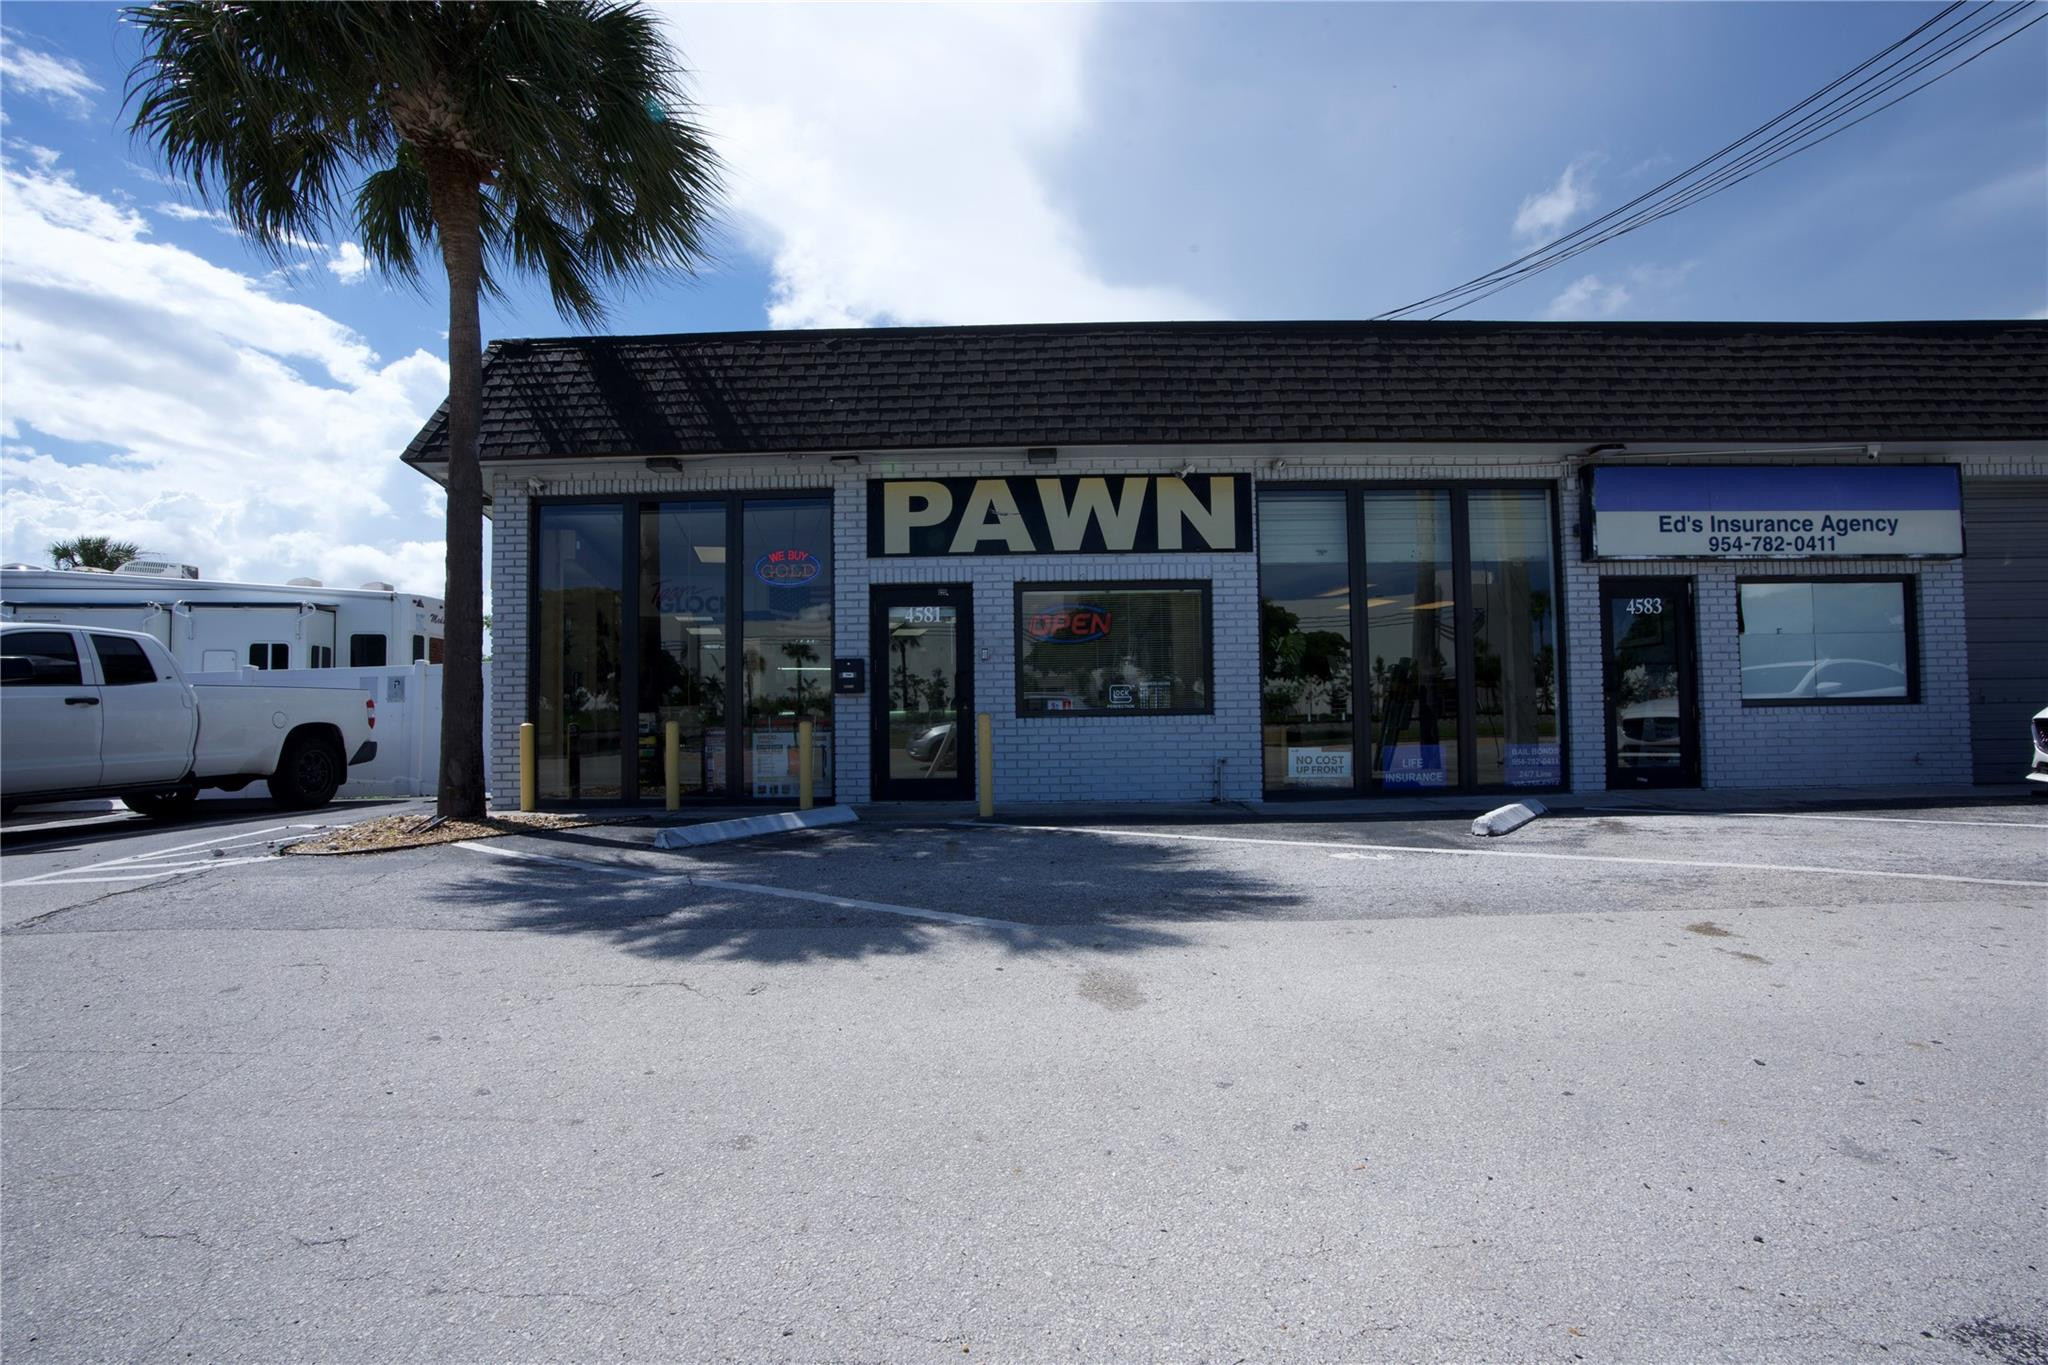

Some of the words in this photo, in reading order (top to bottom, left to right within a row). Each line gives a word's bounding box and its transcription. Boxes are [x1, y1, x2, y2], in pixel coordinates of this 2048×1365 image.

[883, 476, 1236, 555] PAWN
[1658, 515, 1704, 533] Ed's
[1710, 515, 1814, 533] Insurance
[1820, 514, 1899, 536] Agency
[1708, 535, 1836, 552] 954-782-0411
[768, 550, 785, 563] WE
[787, 549, 809, 561] BUY
[760, 563, 817, 579] GOLD
[1626, 597, 1663, 615] 4583
[905, 606, 941, 623] 4581
[1029, 611, 1113, 637] OPEN
[1296, 755, 1313, 765] NO
[1315, 755, 1344, 765] COST
[1402, 758, 1424, 768] LIFE
[1296, 765, 1310, 774] UP
[1311, 765, 1344, 775] FRONT
[1385, 771, 1444, 783] INSURANCE
